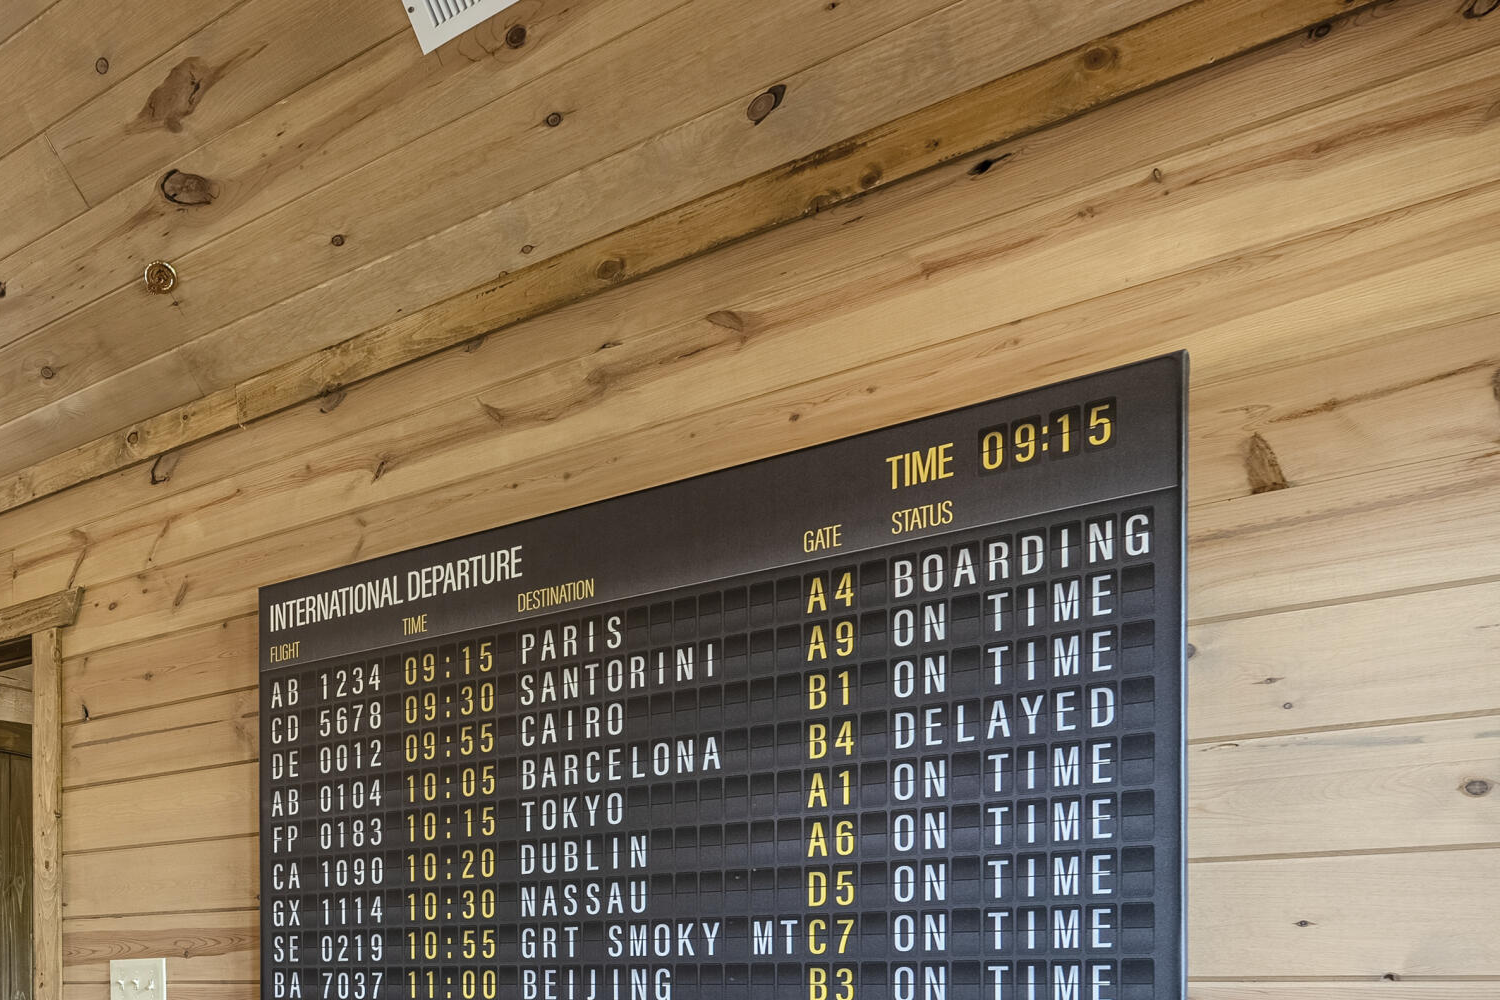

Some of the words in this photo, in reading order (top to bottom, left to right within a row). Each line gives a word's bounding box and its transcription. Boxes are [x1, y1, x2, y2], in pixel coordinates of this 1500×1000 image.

[886, 442, 954, 490] TIME
[983, 405, 1111, 470] 09:15
[270, 640, 301, 663] FLIGHT
[402, 613, 428, 636] TIME
[517, 578, 594, 613] DESTINATION
[804, 524, 842, 553] GATE
[891, 500, 953, 535] STATUS
[270, 575, 404, 633] INTERNATIONAL
[407, 545, 523, 602] DEPARTURE
[271, 678, 299, 709] AB
[320, 663, 381, 700] 1234
[405, 642, 493, 686] 09:15
[522, 616, 622, 665] PARIS
[807, 572, 854, 614] A4
[895, 514, 1150, 598] BOARDING
[271, 715, 299, 744] CD
[319, 701, 381, 737] 5678
[405, 682, 494, 724] 09:30
[520, 643, 713, 706] SANTORINI
[807, 621, 854, 662] A9
[893, 603, 945, 647] ON
[988, 574, 1112, 632] TIME
[272, 750, 299, 780] DE
[320, 739, 382, 774] 0012
[405, 723, 494, 763] 09:55
[522, 703, 623, 747] CAIRO
[809, 671, 849, 710] B1
[894, 655, 945, 698] ON
[988, 630, 1112, 685] TIME
[271, 789, 299, 817] AB
[320, 779, 382, 813] 0104
[407, 765, 495, 803] 10:05
[522, 737, 721, 790] BARCELONA
[809, 721, 854, 759] B4
[895, 687, 1114, 749] DELAYED
[273, 825, 298, 853] FP
[320, 818, 382, 850] 0183
[407, 807, 495, 842] 10:15
[521, 792, 623, 832] TOKYO
[807, 770, 849, 808] A1
[894, 760, 945, 801] ON
[988, 742, 1112, 792] TIME
[273, 862, 301, 890] CA
[322, 856, 383, 888] 1090
[407, 848, 494, 882] 10:20
[521, 835, 646, 875] DUBLIN
[808, 820, 854, 858] A6
[894, 812, 945, 852] ON
[988, 798, 1113, 845] TIME
[273, 899, 301, 927] GX
[322, 896, 383, 926] 1114
[408, 889, 495, 921] 10:30
[521, 881, 646, 917] NASSAU
[808, 871, 854, 907] D5
[894, 864, 945, 903] ON
[988, 854, 1112, 898] TIME
[273, 935, 299, 963] SE
[321, 934, 382, 962] 0219
[408, 929, 495, 960] 10:55
[521, 926, 579, 959] GRT
[608, 922, 720, 957] SMOKY
[753, 920, 798, 955] MT
[809, 919, 854, 955] C7
[894, 914, 945, 952] ON
[988, 908, 1113, 950] TIME
[274, 972, 301, 998] BA
[322, 972, 383, 1000] 7037
[408, 970, 496, 1000] 11:00
[523, 968, 671, 1000] BEIJING
